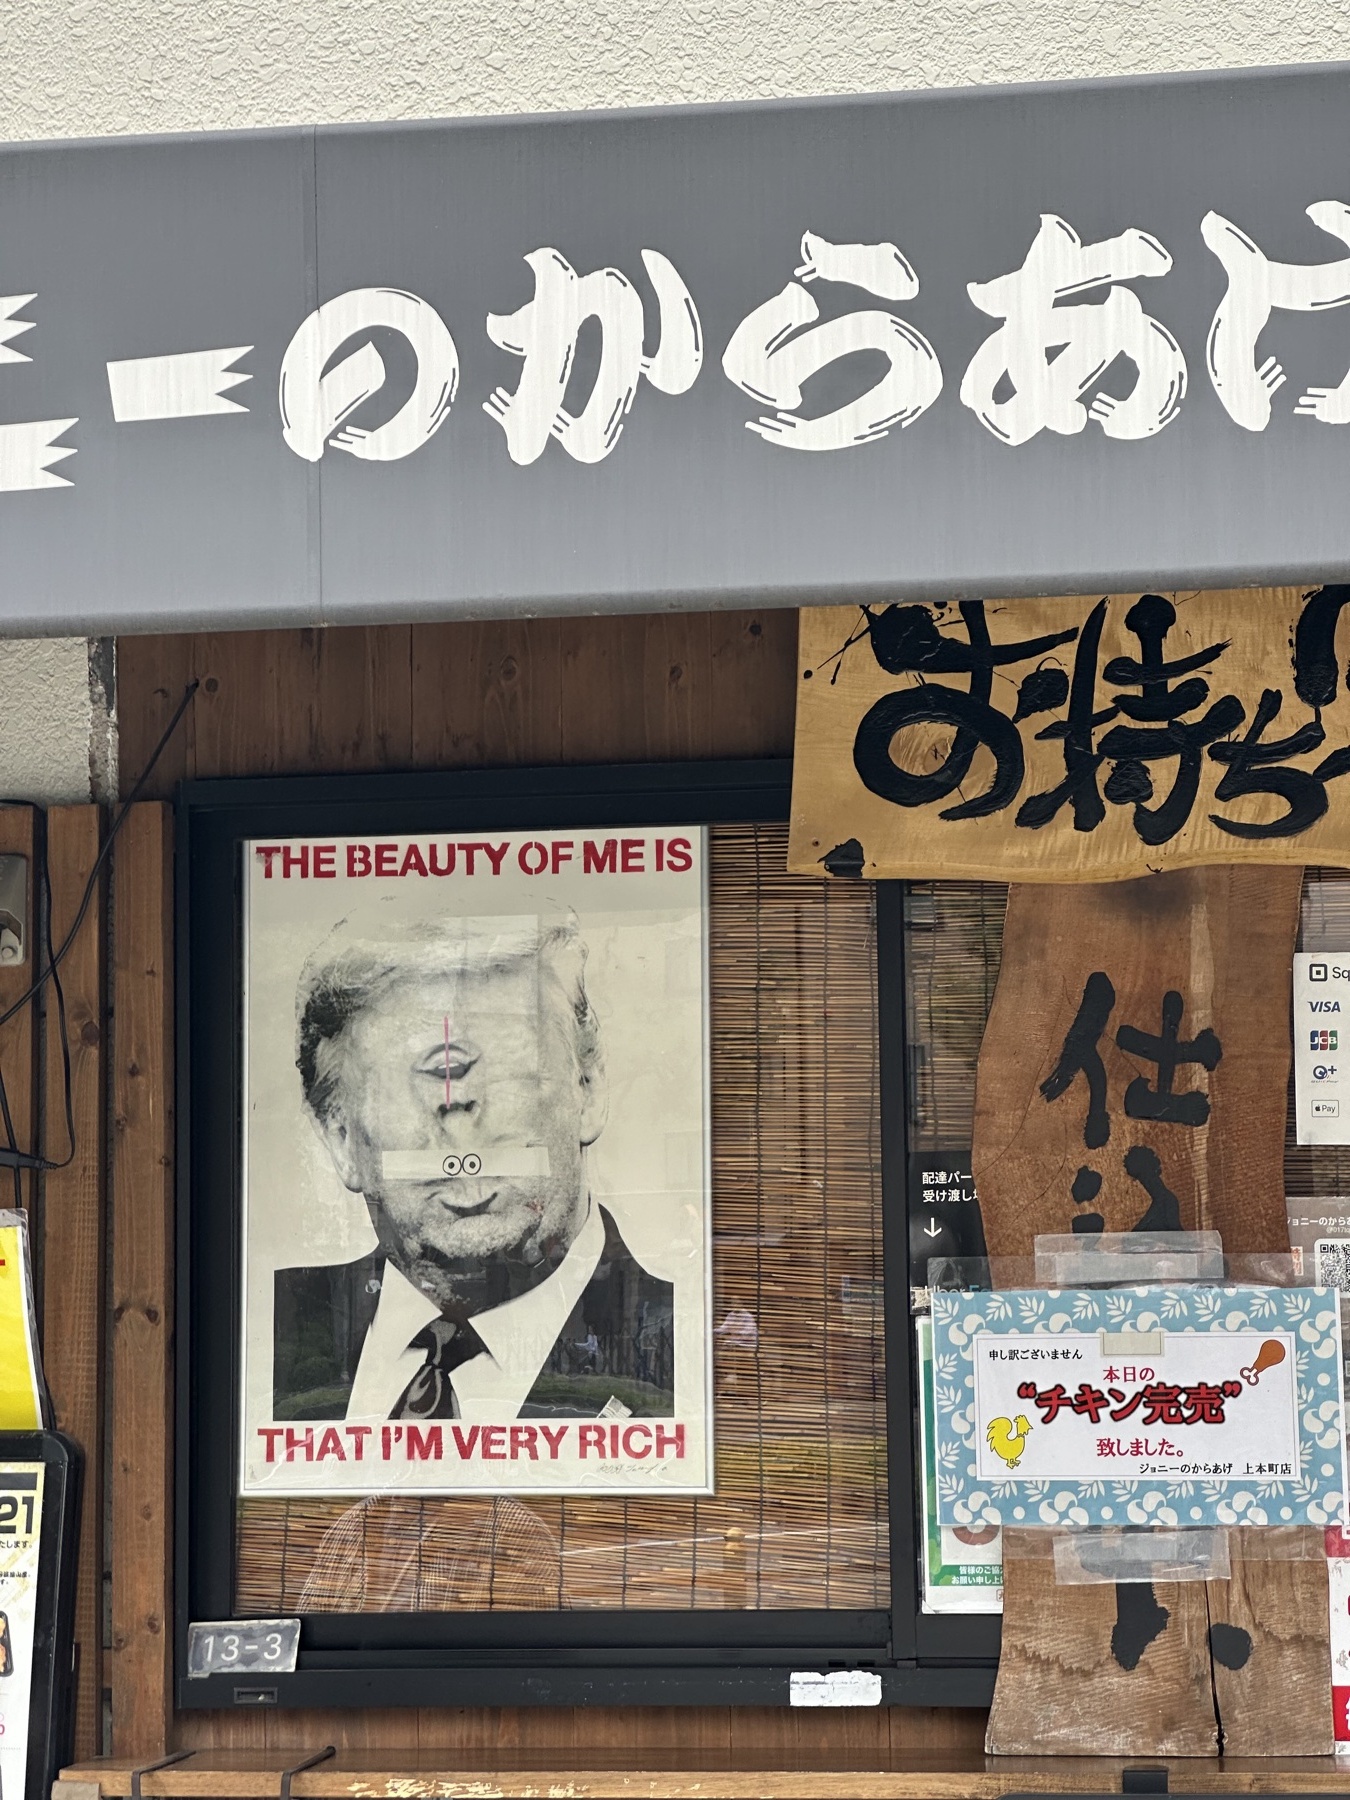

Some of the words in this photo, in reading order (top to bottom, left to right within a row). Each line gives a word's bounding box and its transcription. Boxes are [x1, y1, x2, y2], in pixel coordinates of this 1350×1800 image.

[256, 845, 336, 879] THE
[346, 842, 510, 877] BEAUTY
[517, 841, 574, 876] OF
[583, 839, 646, 874] ME
[655, 837, 693, 872] IS
[1308, 1001, 1341, 1013] VISA
[1310, 1034, 1338, 1047] JCB
[1321, 1104, 1336, 1114] Pay
[989, 1349, 1083, 1361] 申し訳ございません
[1102, 1365, 1155, 1383] 本日の
[257, 1426, 371, 1462] THAT
[381, 1425, 444, 1461] I'M
[452, 1424, 569, 1460] VERY
[578, 1423, 685, 1459] RICH
[1096, 1437, 1184, 1458] 致しました。
[1138, 1463, 1233, 1475] ジョニーのからあげ
[1242, 1463, 1292, 1475] 上本町店
[204, 1632, 282, 1662] 13-3
